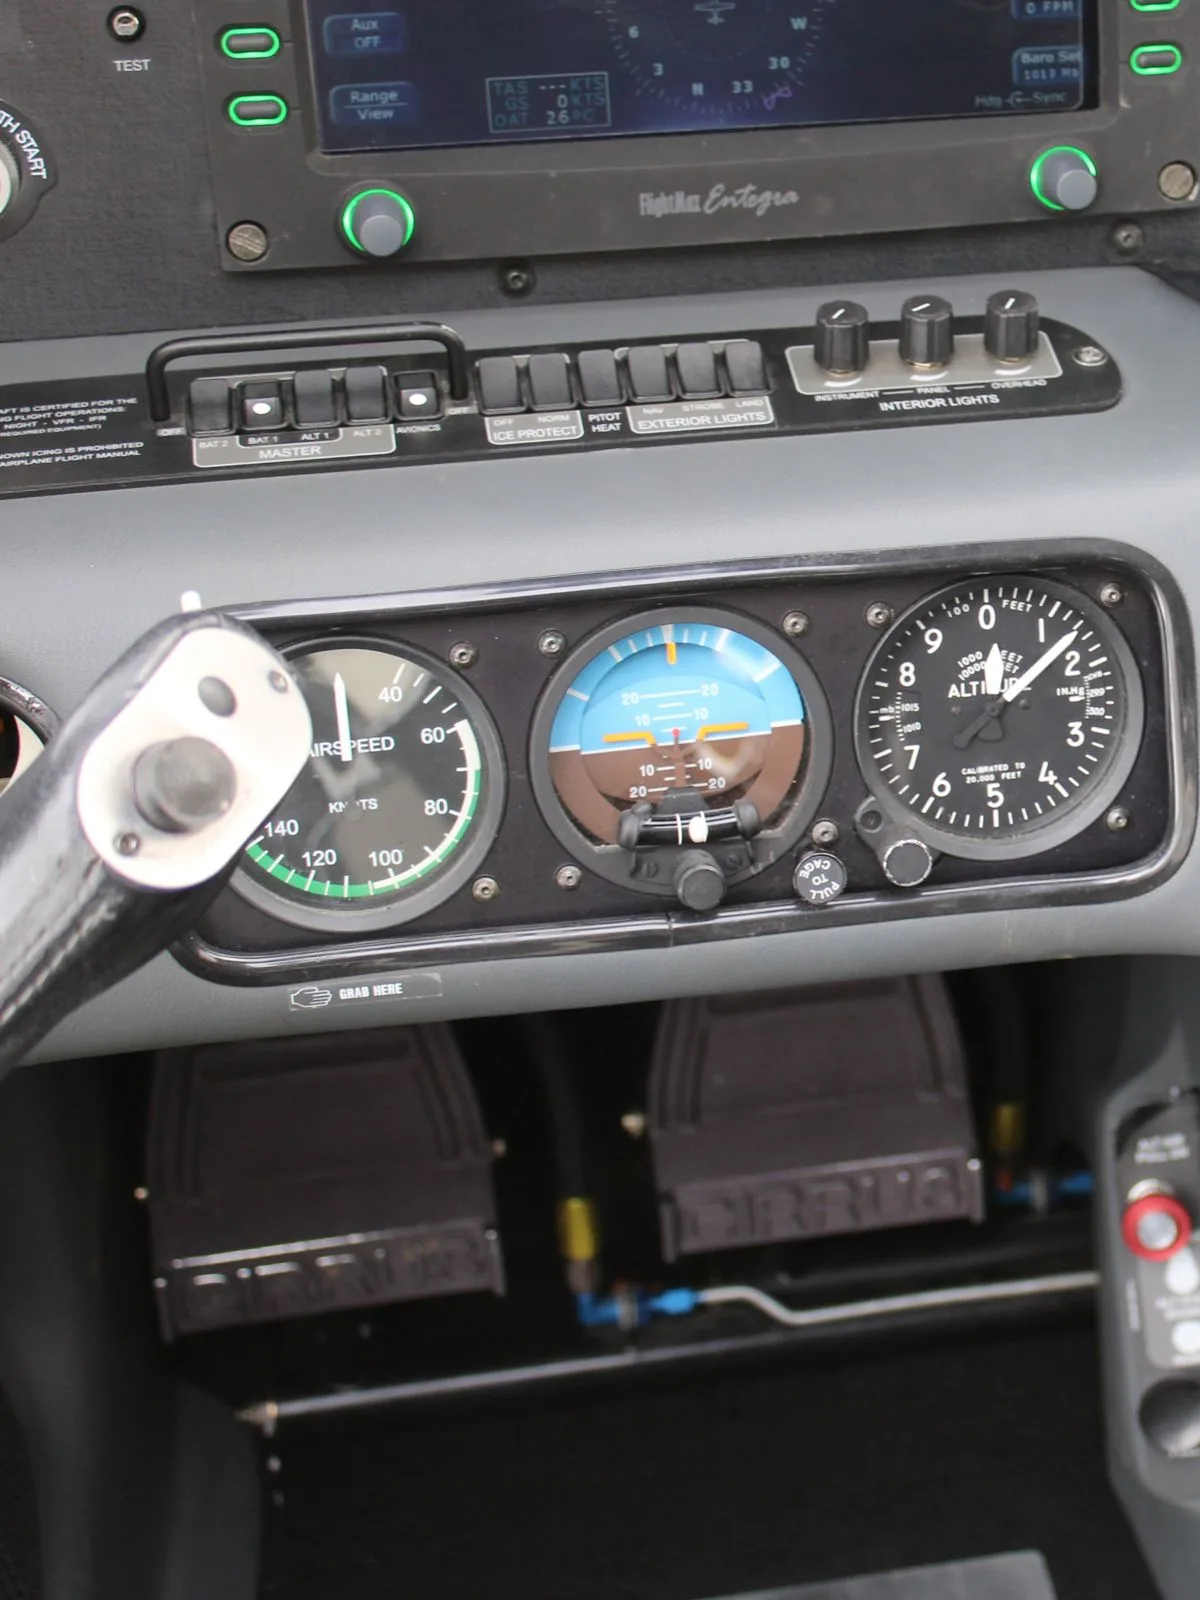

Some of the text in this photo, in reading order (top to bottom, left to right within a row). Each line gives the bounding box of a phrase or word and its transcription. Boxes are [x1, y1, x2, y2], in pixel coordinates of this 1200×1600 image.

[352, 19, 378, 30] Aux
[113, 59, 151, 72] TEST
[769, 57, 789, 69] 30
[351, 91, 398, 102] Range
[358, 108, 394, 120] View
[704, 184, 799, 216] Entegra
[991, 378, 1047, 389] OVERHEAD
[815, 390, 880, 401] INSTRUMENT
[879, 394, 999, 411] INTERIOR LIGHTS
[33, 402, 88, 412] CERTIFIED
[682, 401, 724, 412] STROBE
[538, 414, 569, 423] NORM
[638, 411, 766, 429] EXTERIOR LIGHTS
[396, 424, 441, 434] AVIONICS
[493, 425, 577, 441] ICE PROTECT
[78, 442, 144, 452] PROHIBITED
[259, 446, 322, 459] MASTER
[0, 450, 141, 467] AIRPLANE FLIGHT MANUAL
[948, 600, 1032, 618] 100 FEET
[978, 605, 996, 629] 0
[925, 629, 943, 654] 9
[1065, 651, 1081, 676] 2
[900, 662, 915, 687] 8
[378, 686, 403, 702] 40
[622, 684, 719, 705] 20 20
[635, 709, 708, 726] 10 10
[421, 727, 445, 744] 60
[1067, 722, 1085, 747] 3
[903, 745, 920, 770] 7
[639, 758, 712, 776] 10 10
[961, 764, 1009, 775] CALIBRATED
[1038, 761, 1057, 785] 4
[630, 778, 725, 798] 20 20
[932, 772, 951, 796] 6
[987, 783, 1004, 808] 5
[424, 799, 448, 815] 80
[265, 820, 299, 836] 140
[302, 849, 337, 867] 120
[369, 849, 403, 866] 100
[800, 860, 831, 879] CAGE
[812, 874, 828, 885] TO
[809, 881, 840, 899] PULL
[339, 983, 403, 1000] GRAB HERE
